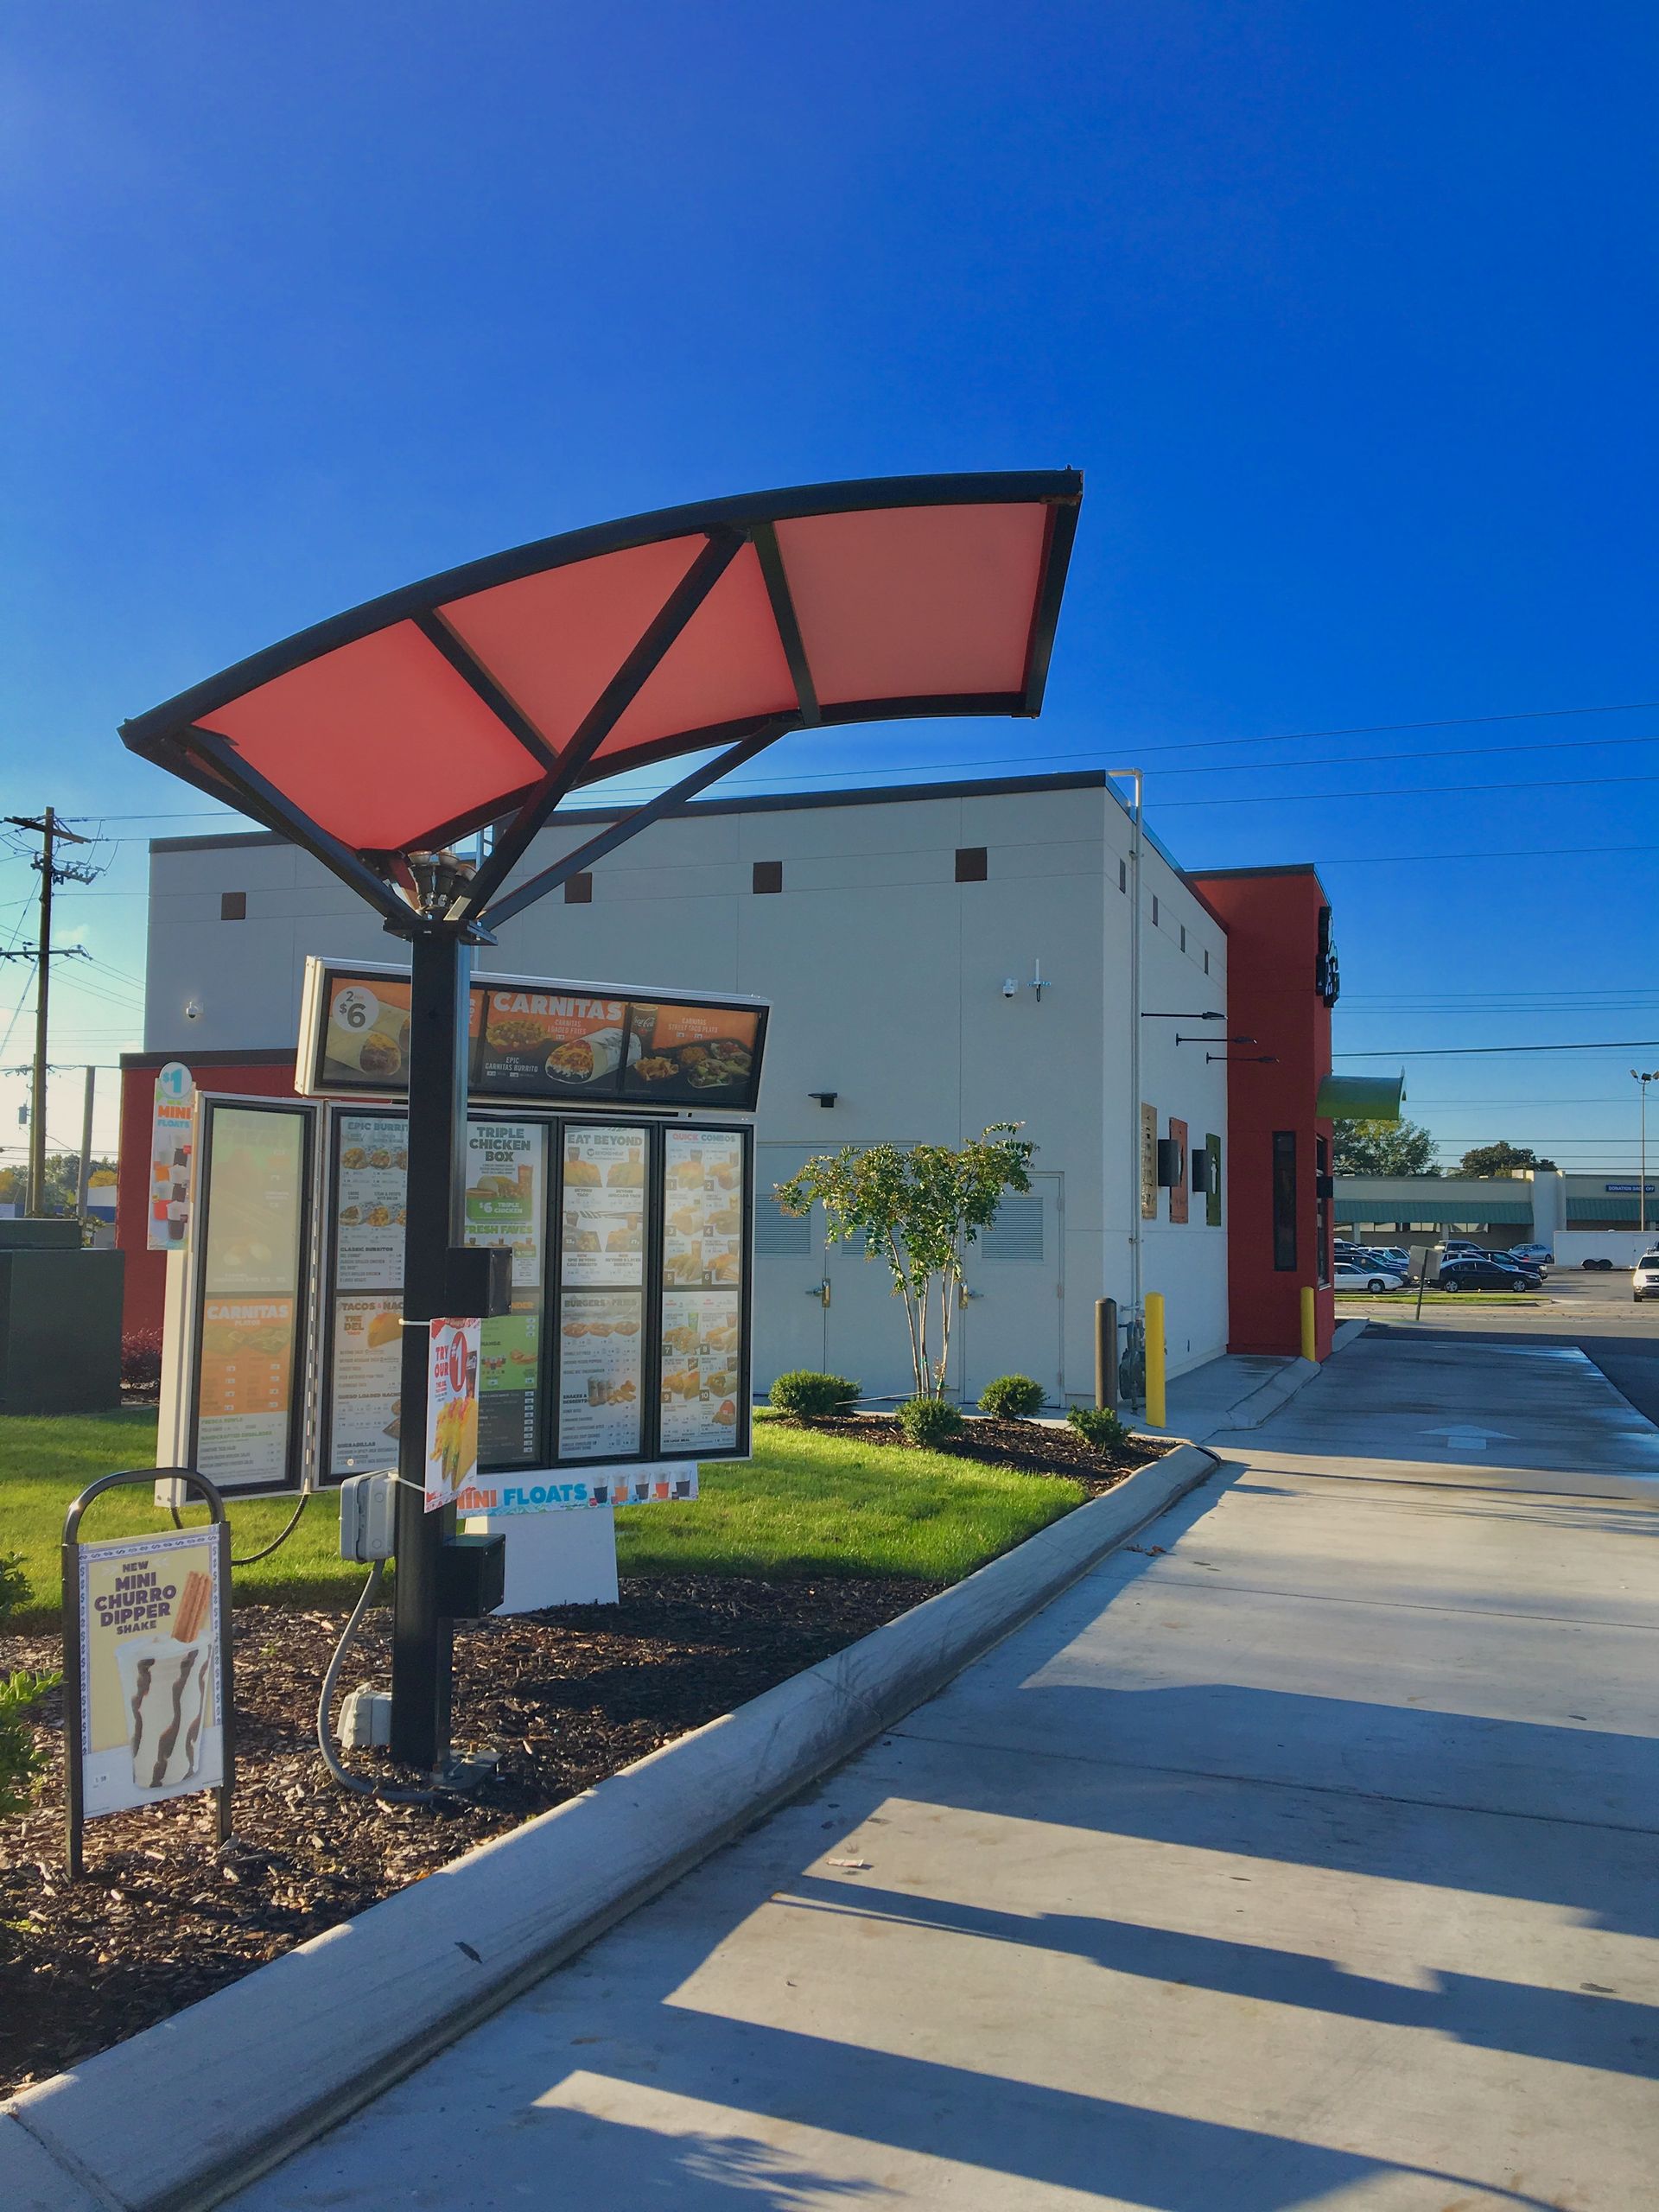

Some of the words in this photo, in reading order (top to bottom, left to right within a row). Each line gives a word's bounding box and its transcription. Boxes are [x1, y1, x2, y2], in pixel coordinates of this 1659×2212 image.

[346, 991, 353, 1001] 2
[493, 991, 622, 1020] CARNITAS
[339, 1003, 365, 1028] $6
[485, 1062, 512, 1071] CARNITAS
[513, 1064, 538, 1072] BURRITO
[162, 1068, 182, 1093] $1
[157, 1105, 191, 1120] MINI
[157, 1119, 189, 1128] FLOATS
[348, 1122, 371, 1131] EPIC
[477, 1127, 524, 1139] TRIPLE
[701, 1134, 736, 1142] COMBOS
[469, 1138, 531, 1151] CHICKEN
[568, 1134, 591, 1144] EAT
[594, 1135, 643, 1147] BEYOND
[486, 1151, 514, 1162] BOX
[480, 1202, 493, 1213] $6
[341, 1302, 375, 1311] TACOS
[564, 1299, 607, 1307] BURGERS
[207, 1305, 288, 1320] CARNITAS
[435, 1345, 449, 1361] TRY
[435, 1362, 448, 1378] OUR
[504, 1484, 588, 1507] FLOATS
[122, 1560, 149, 1573] NEW
[116, 1572, 156, 1592] MINI
[94, 1585, 176, 1611] CHURRO
[101, 1603, 170, 1627] DIPPER
[117, 1620, 156, 1635] SHAKE
